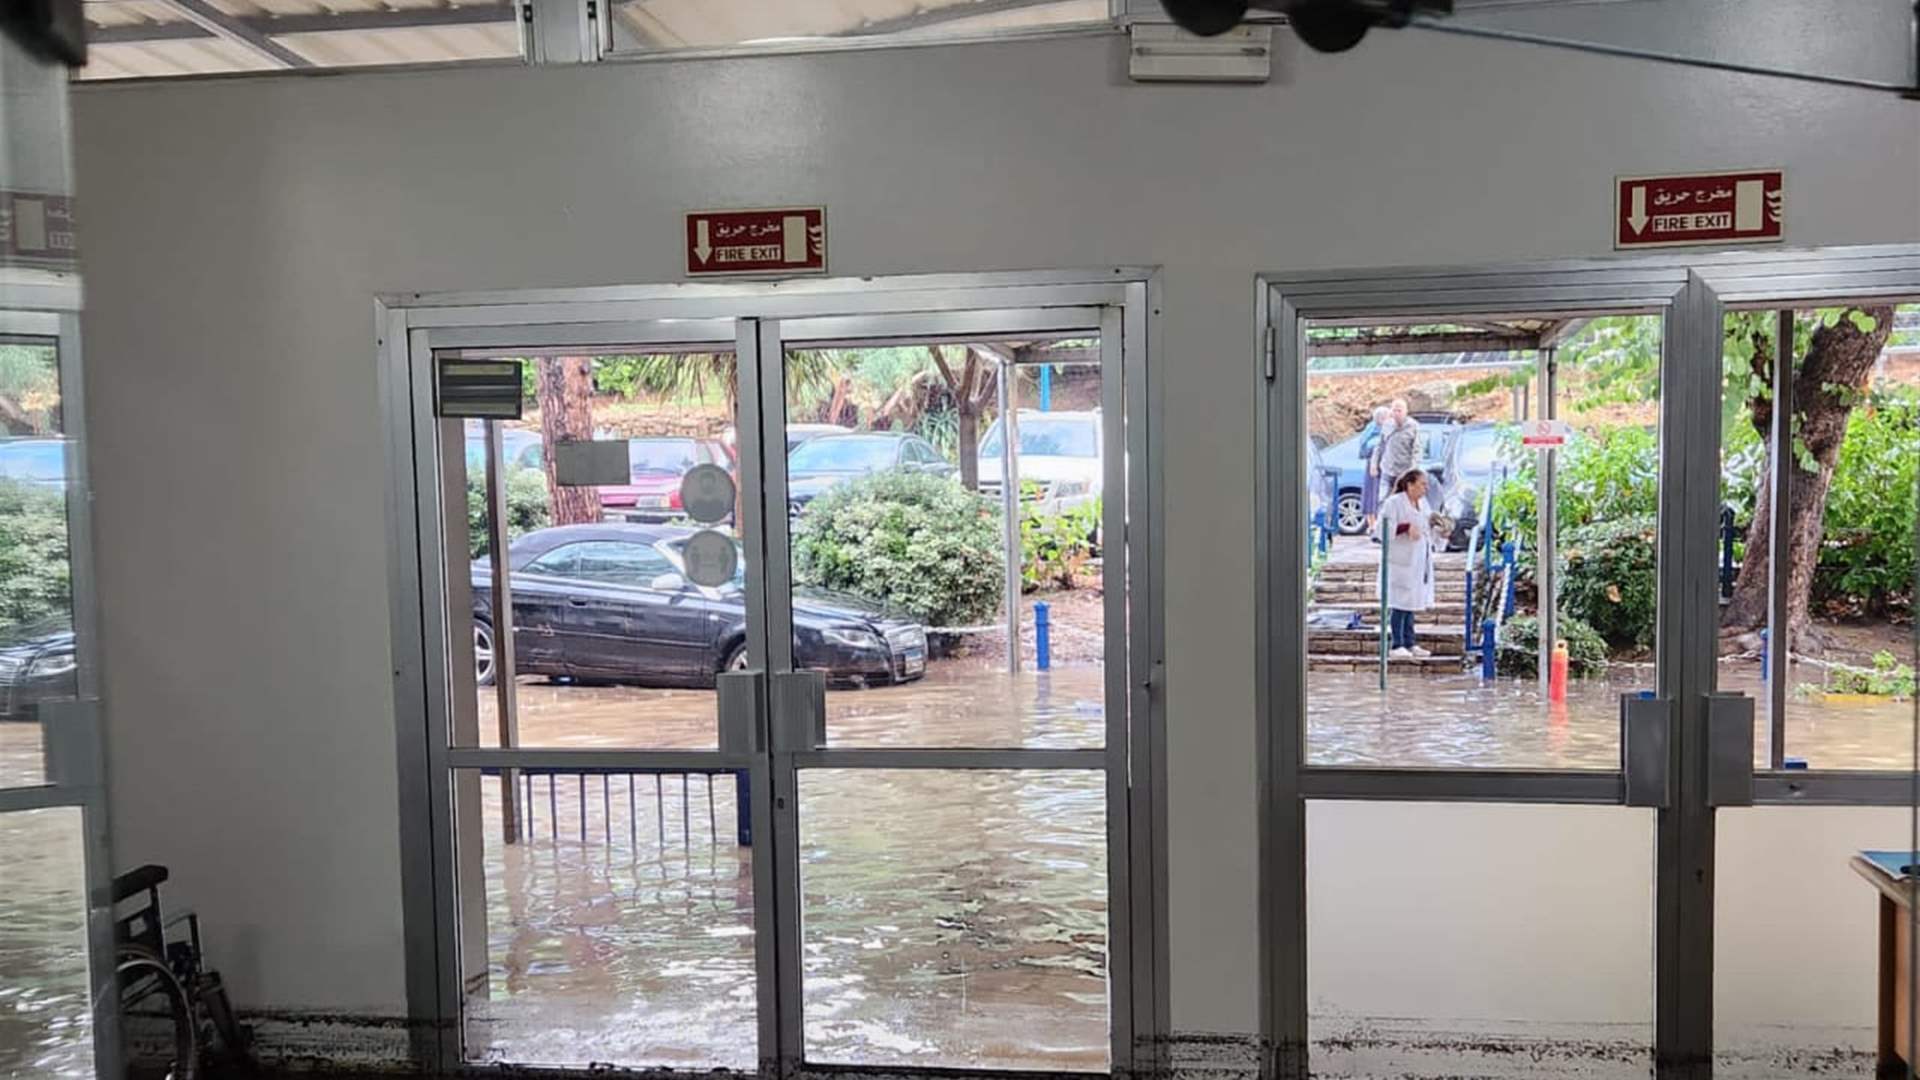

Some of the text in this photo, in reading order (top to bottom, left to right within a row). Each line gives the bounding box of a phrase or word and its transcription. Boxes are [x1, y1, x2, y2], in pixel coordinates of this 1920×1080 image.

[1654, 185, 1733, 206] مخرج حريق
[716, 219, 781, 238] مخرج حريق
[1654, 215, 1729, 230] FIRE EXIT
[717, 247, 779, 261] FIRE EXIT
